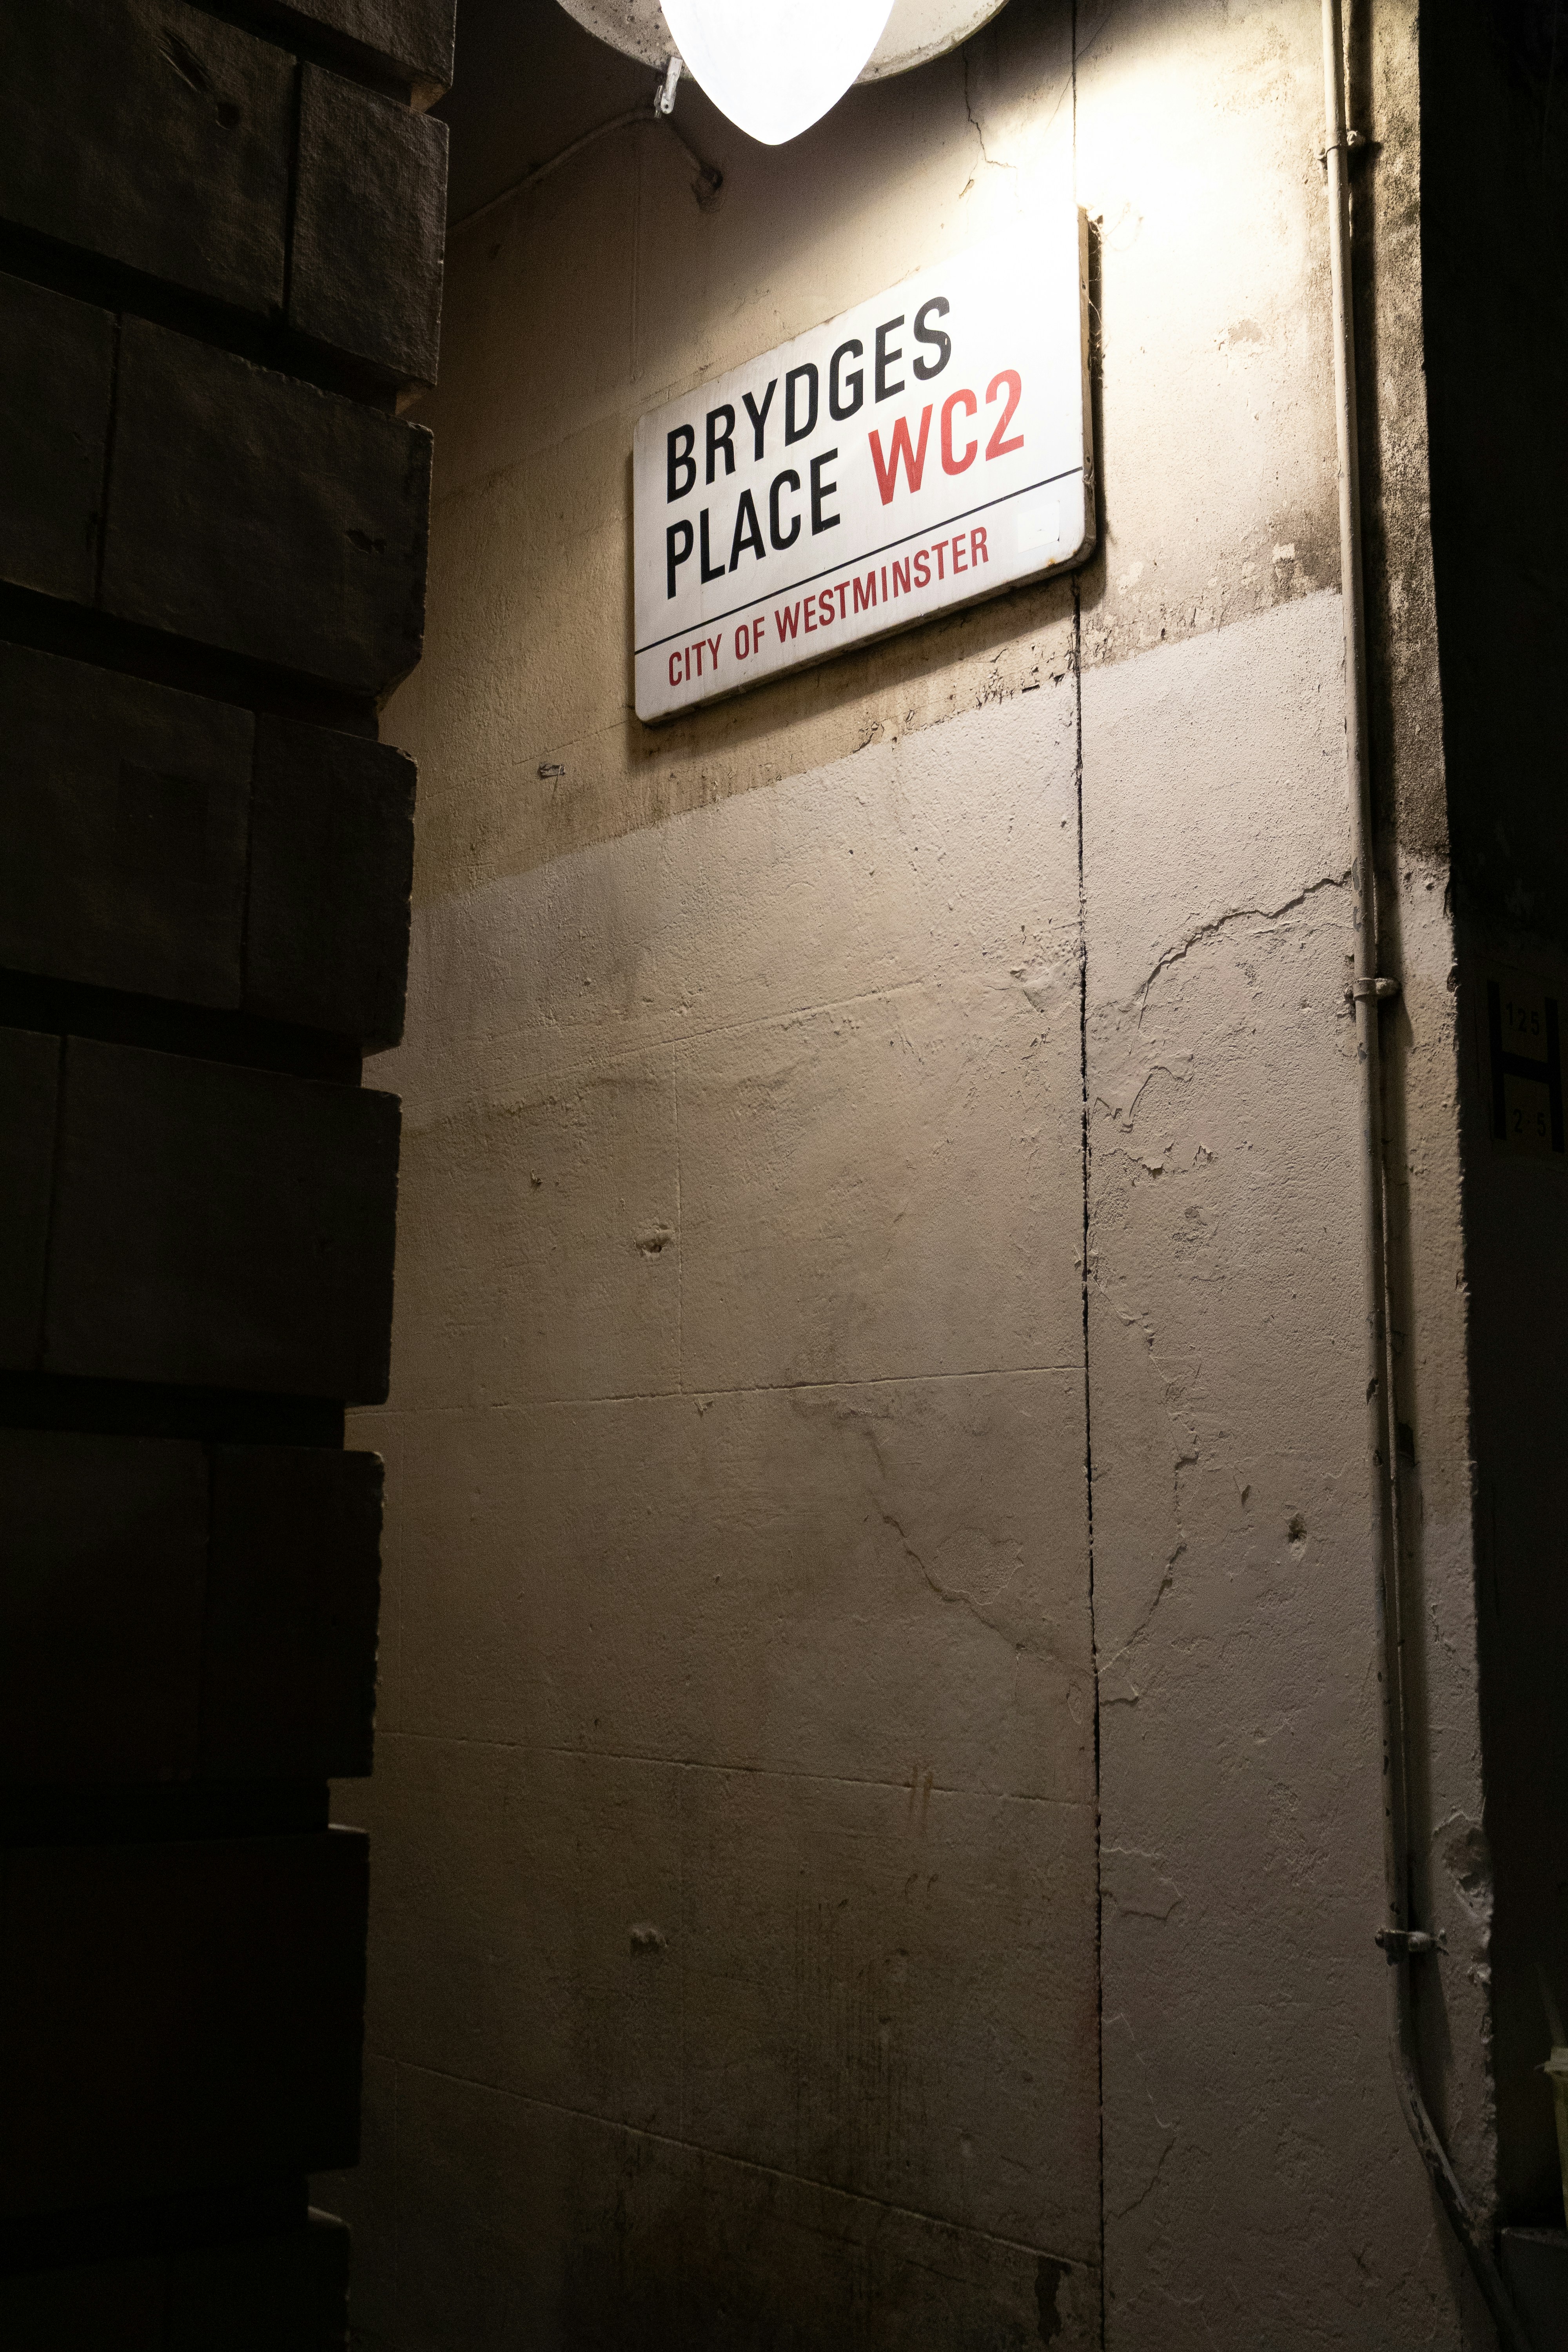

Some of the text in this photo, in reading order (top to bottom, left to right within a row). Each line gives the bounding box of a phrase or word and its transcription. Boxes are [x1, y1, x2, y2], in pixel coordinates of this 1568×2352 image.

[667, 370, 1024, 599] PLACE WC2
[668, 297, 951, 503] BRYDGES
[668, 527, 989, 686] CITY OF WESTMINSTER
[1487, 981, 1564, 1152] H
[1506, 1002, 1540, 1035] 125
